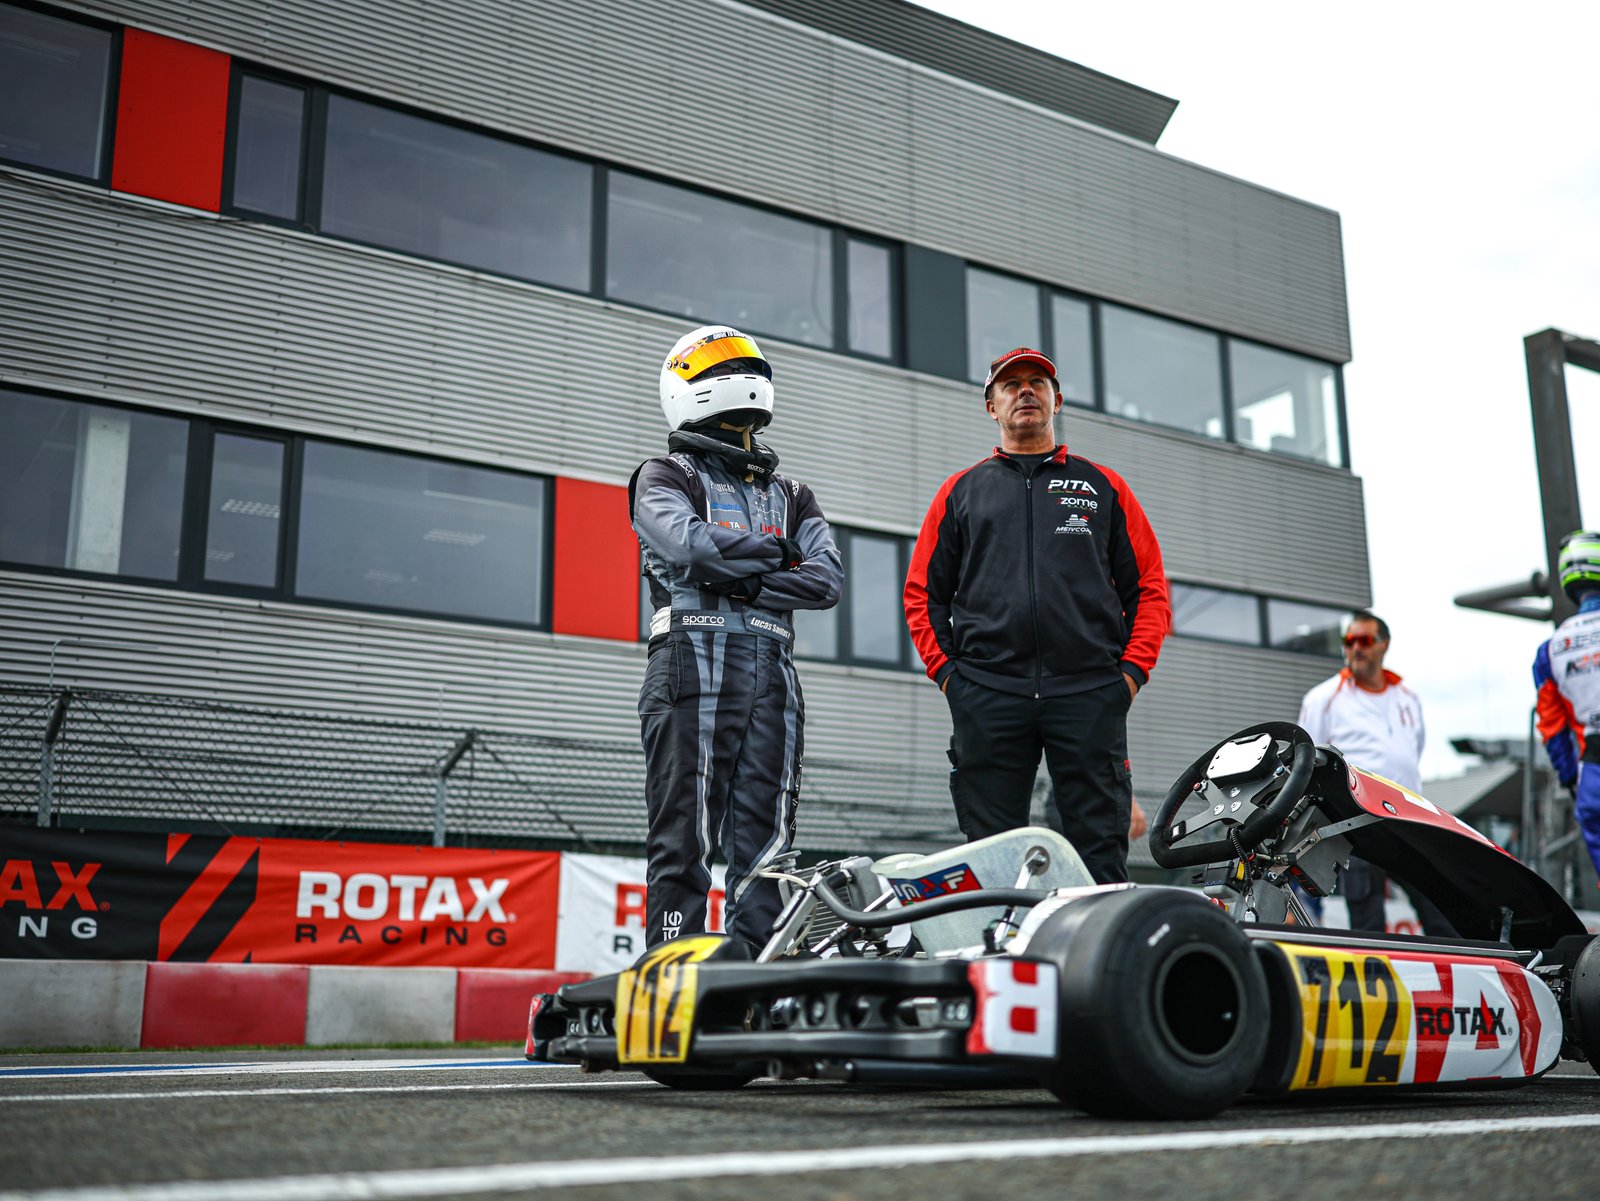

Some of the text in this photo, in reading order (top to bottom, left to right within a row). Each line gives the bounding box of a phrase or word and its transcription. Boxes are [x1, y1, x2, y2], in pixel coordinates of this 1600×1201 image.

[1048, 480, 1098, 495] PITA
[1060, 498, 1098, 509] zome
[682, 615, 725, 626] sparco
[750, 616, 773, 631] Lucas
[296, 871, 511, 923] ROTAX
[295, 924, 508, 946] RACING
[1295, 954, 1401, 1087] 712
[1417, 1006, 1508, 1036] ROTAX
